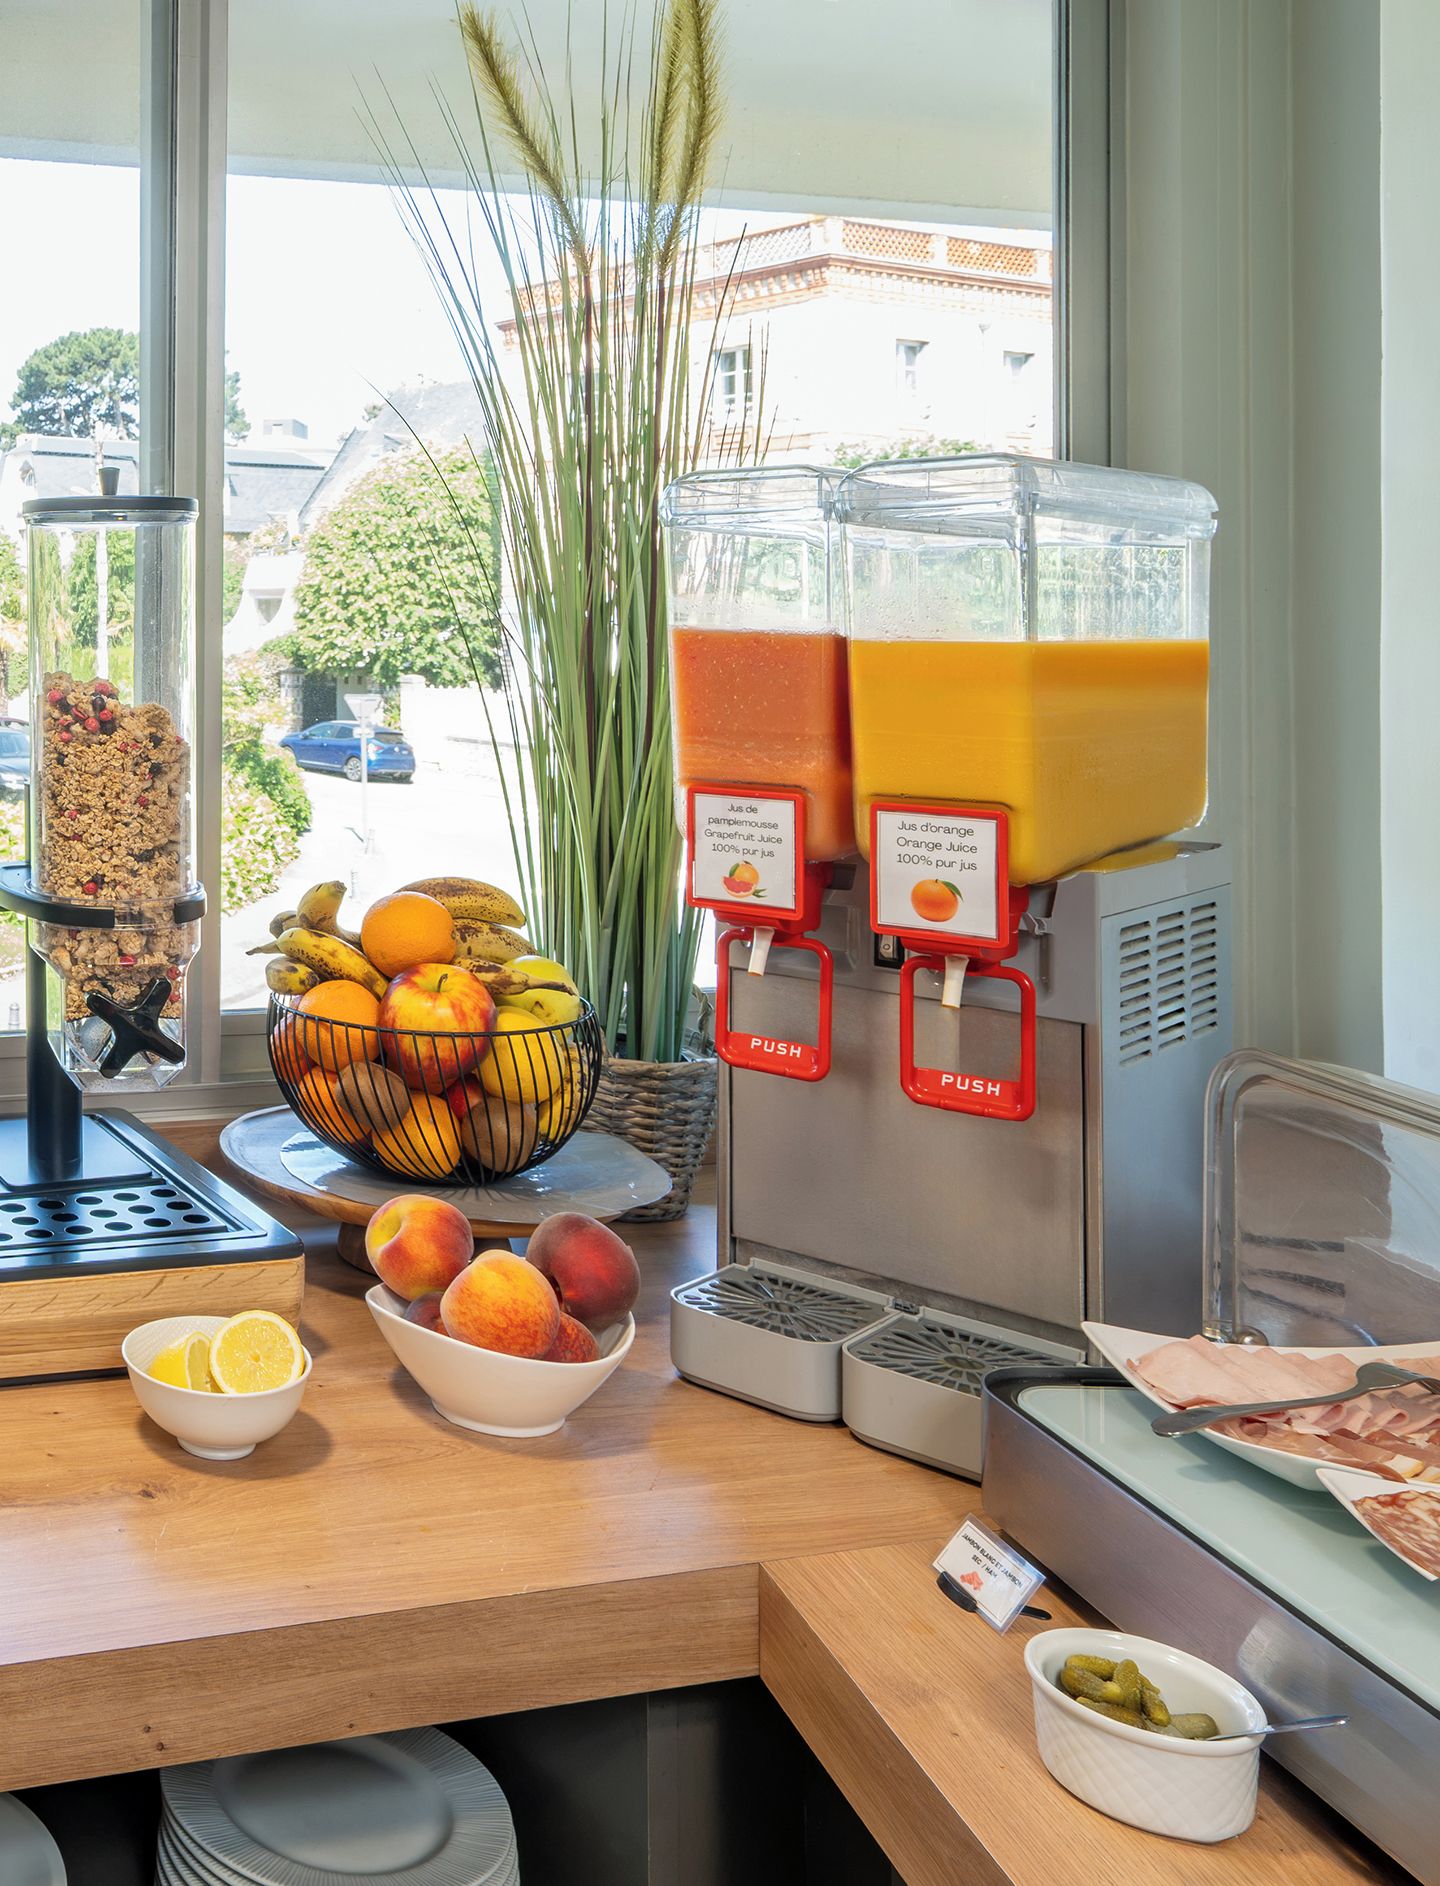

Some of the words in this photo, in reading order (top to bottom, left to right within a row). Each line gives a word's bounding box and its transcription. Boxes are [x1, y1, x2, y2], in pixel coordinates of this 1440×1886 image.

[728, 804, 744, 813] Jus
[745, 805, 758, 814] de
[707, 817, 779, 830] pamplemousse
[897, 821, 918, 831] Jus
[920, 822, 975, 838] d'orange
[704, 828, 756, 842] Grapefruit
[757, 834, 783, 844] Juice
[896, 836, 942, 852] Orange
[945, 842, 978, 853] Juice
[712, 843, 741, 854] 100%
[742, 847, 760, 856] pur
[760, 848, 775, 858] jus
[896, 853, 933, 866] 100%
[935, 859, 957, 869] pur
[959, 859, 977, 872] jus
[750, 1037, 802, 1058] PUSH
[941, 1073, 1001, 1096] PUSH
[961, 1533, 981, 1552] JAMBON
[980, 1548, 997, 1565] BLANC
[994, 1561, 1004, 1570] ET
[971, 1554, 983, 1566] SEC
